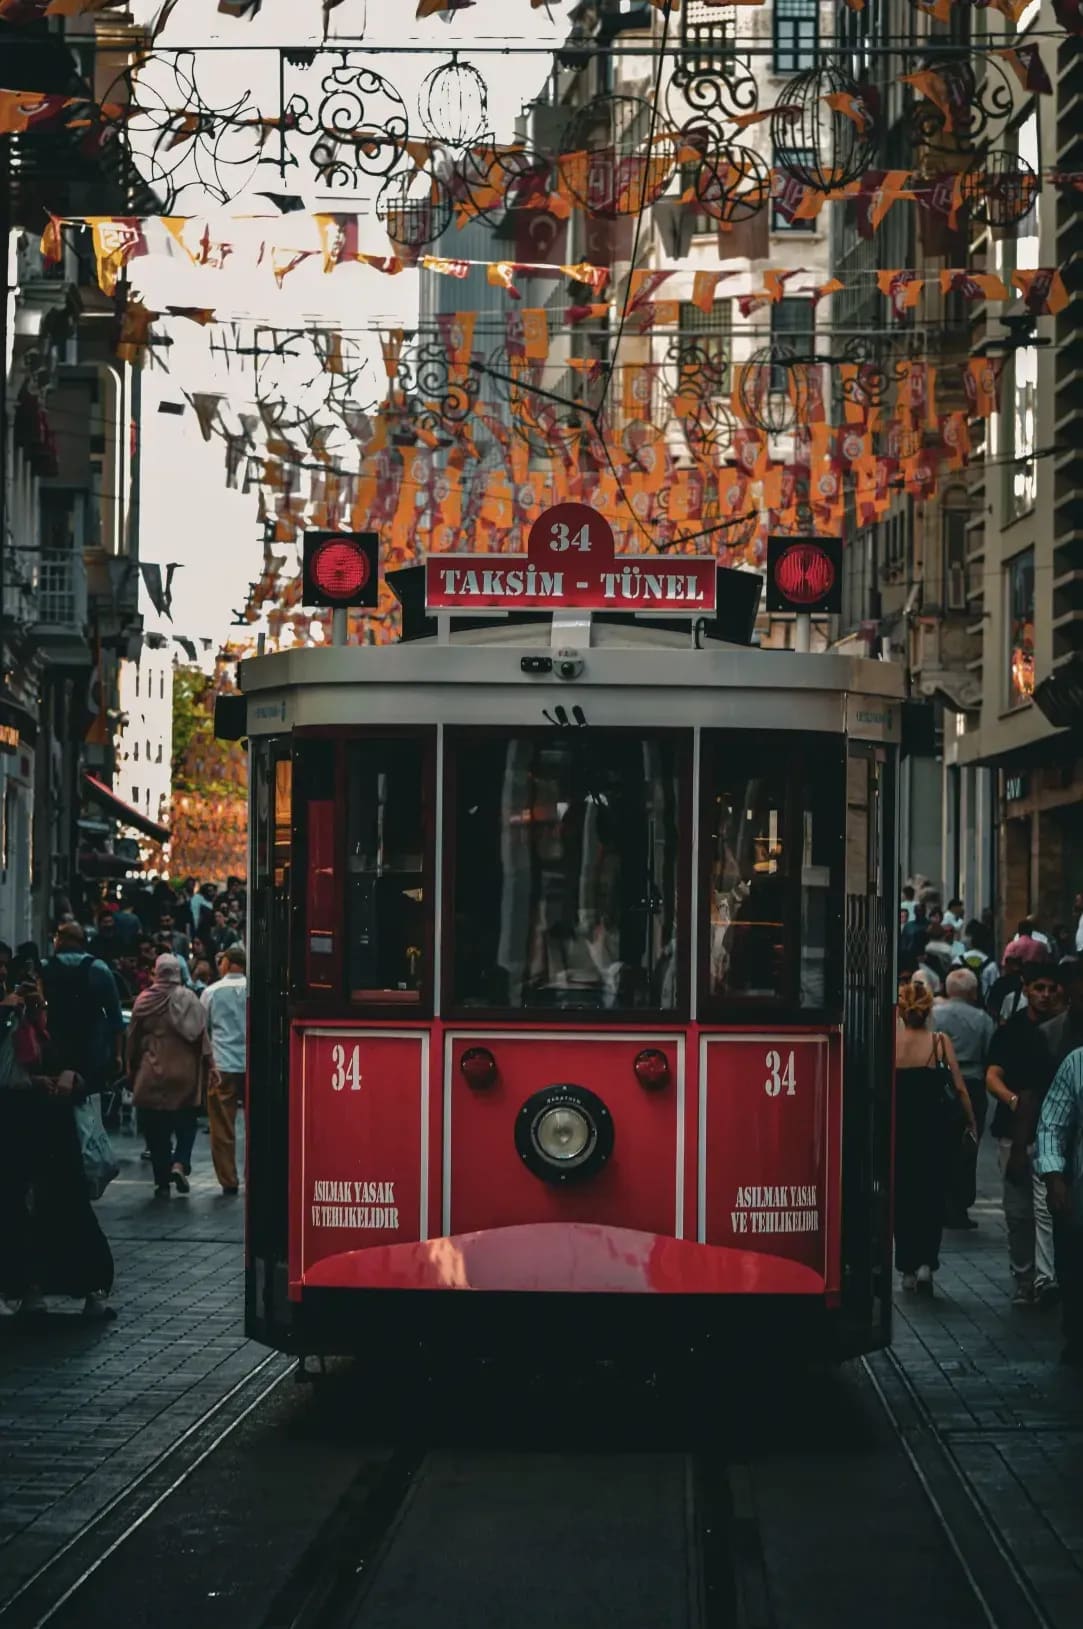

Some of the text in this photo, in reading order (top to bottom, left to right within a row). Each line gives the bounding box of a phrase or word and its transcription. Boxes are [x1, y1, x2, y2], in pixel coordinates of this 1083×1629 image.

[549, 523, 592, 552] 34
[440, 563, 564, 597] TAKSİM
[600, 566, 704, 601] TÜNEL
[331, 1044, 362, 1092] 34
[765, 1050, 797, 1097] 34
[313, 1180, 395, 1204] ASILMAK YASAK
[735, 1185, 817, 1208] ASILMAK YASAK
[311, 1205, 320, 1227] VE
[730, 1212, 748, 1233] VE
